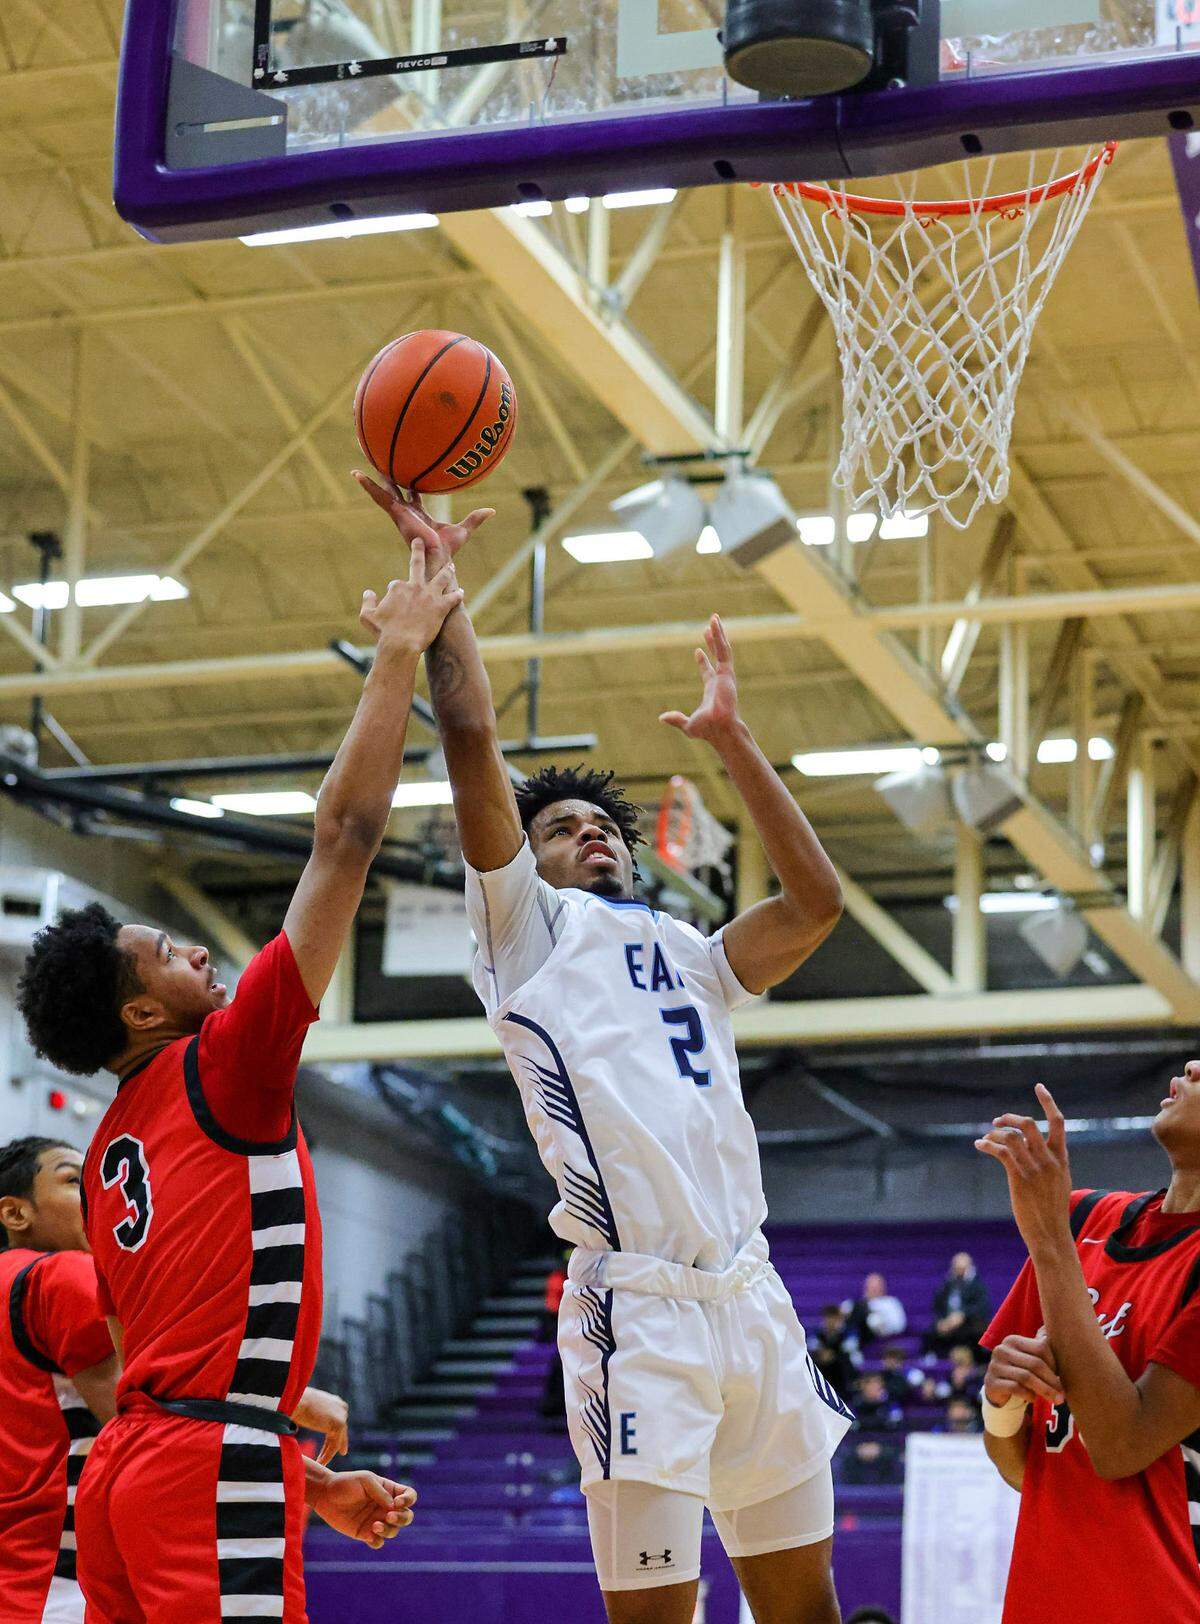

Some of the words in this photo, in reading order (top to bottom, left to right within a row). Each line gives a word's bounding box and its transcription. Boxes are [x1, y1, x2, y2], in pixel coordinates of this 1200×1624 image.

[444, 380, 514, 479] Wilson
[623, 942, 685, 993] EA
[658, 1003, 712, 1088] 2
[100, 1132, 154, 1253] 3
[620, 1412, 637, 1455] E
